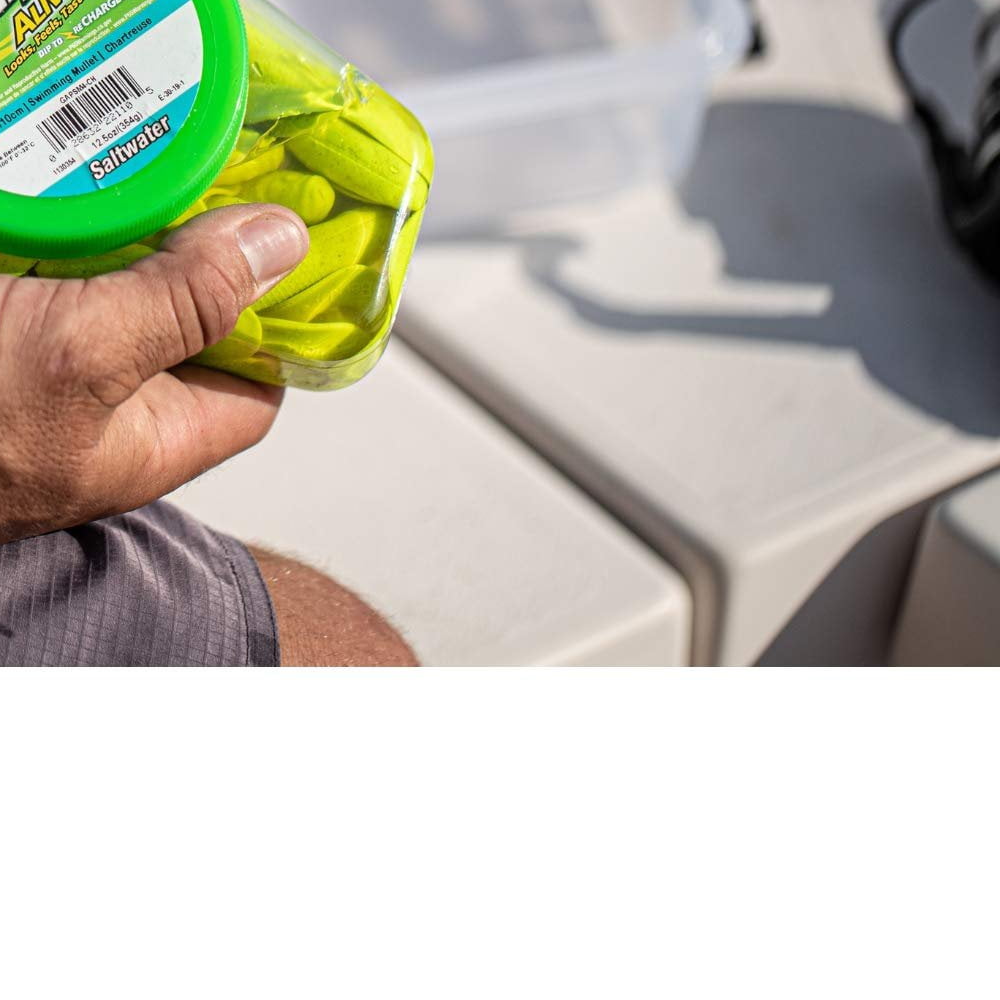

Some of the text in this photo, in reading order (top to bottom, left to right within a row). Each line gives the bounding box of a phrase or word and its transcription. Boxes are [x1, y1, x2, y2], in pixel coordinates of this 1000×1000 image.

[4, 43, 37, 78] Looks,
[33, 17, 64, 47] Feels,
[27, 72, 74, 109] Swimming
[70, 53, 99, 77] Mullet
[103, 17, 153, 54] Chartreuse
[37, 44, 53, 58] DIP
[51, 36, 64, 48] TO
[48, 86, 154, 163] 0 28632 22110 5
[88, 114, 173, 180] Saltwater
